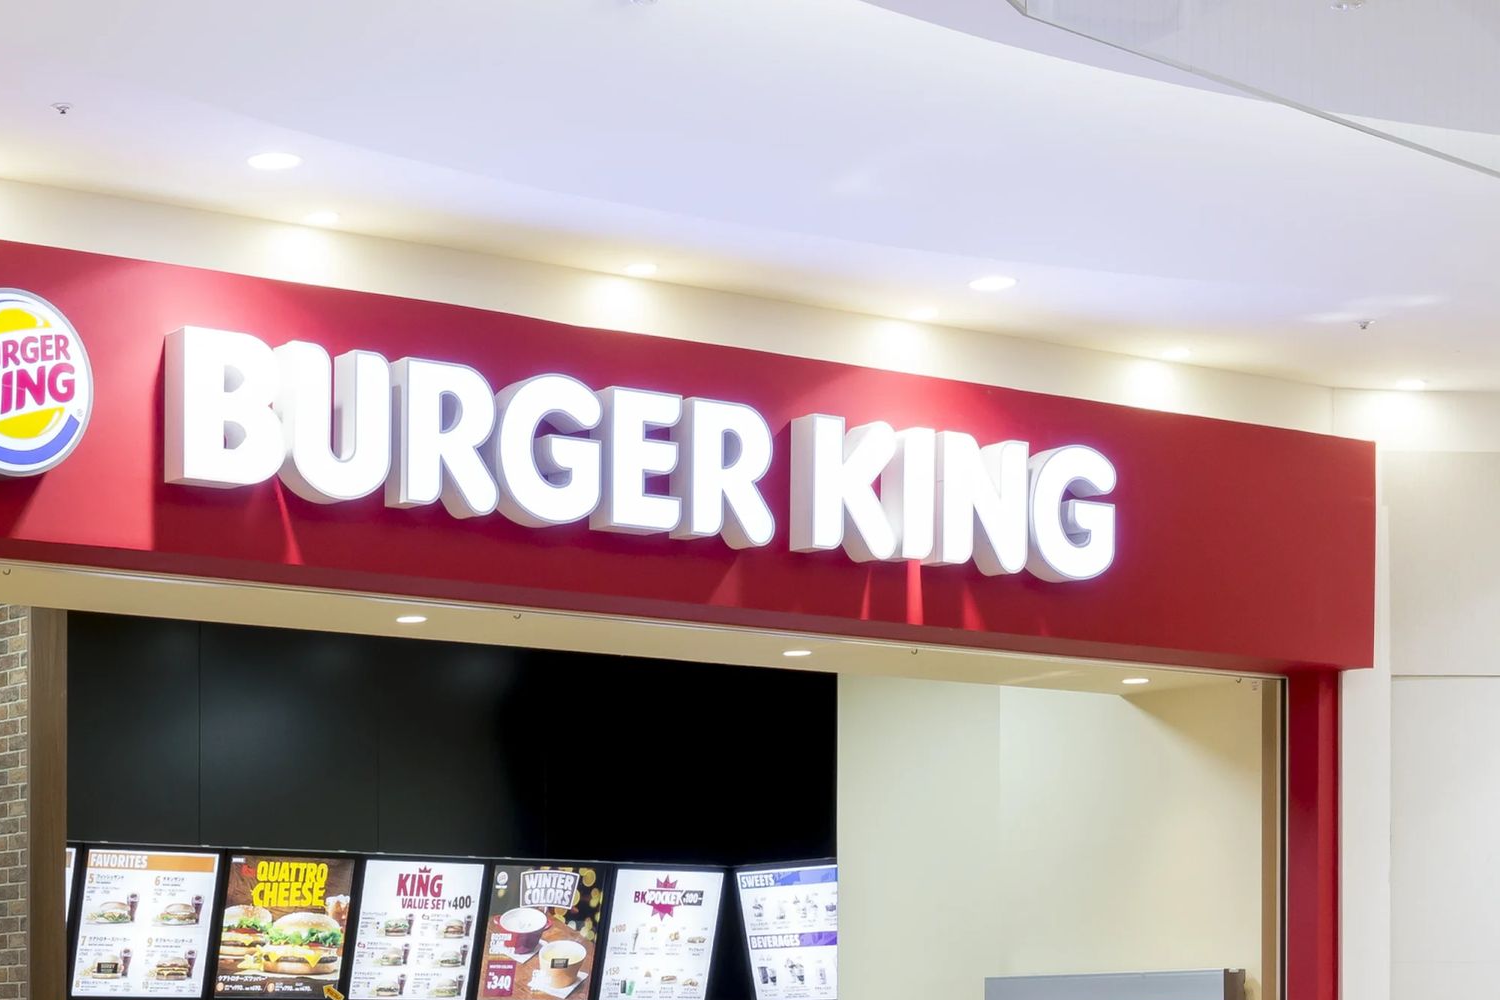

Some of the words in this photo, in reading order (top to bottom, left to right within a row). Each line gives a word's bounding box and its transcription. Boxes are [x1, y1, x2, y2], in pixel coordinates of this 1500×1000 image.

[165, 325, 775, 549] BURGER
[790, 413, 1116, 582] KING
[90, 854, 148, 868] FAVORITES
[257, 861, 329, 883] QUATTRO
[741, 874, 775, 888] SWEETS
[397, 873, 443, 897] KING
[525, 873, 575, 891] WINTER
[252, 881, 326, 907] CHEESE
[524, 887, 572, 906] COLORS
[401, 898, 429, 909] VALUE
[431, 899, 445, 910] SET
[751, 934, 800, 949] BEVERAGES
